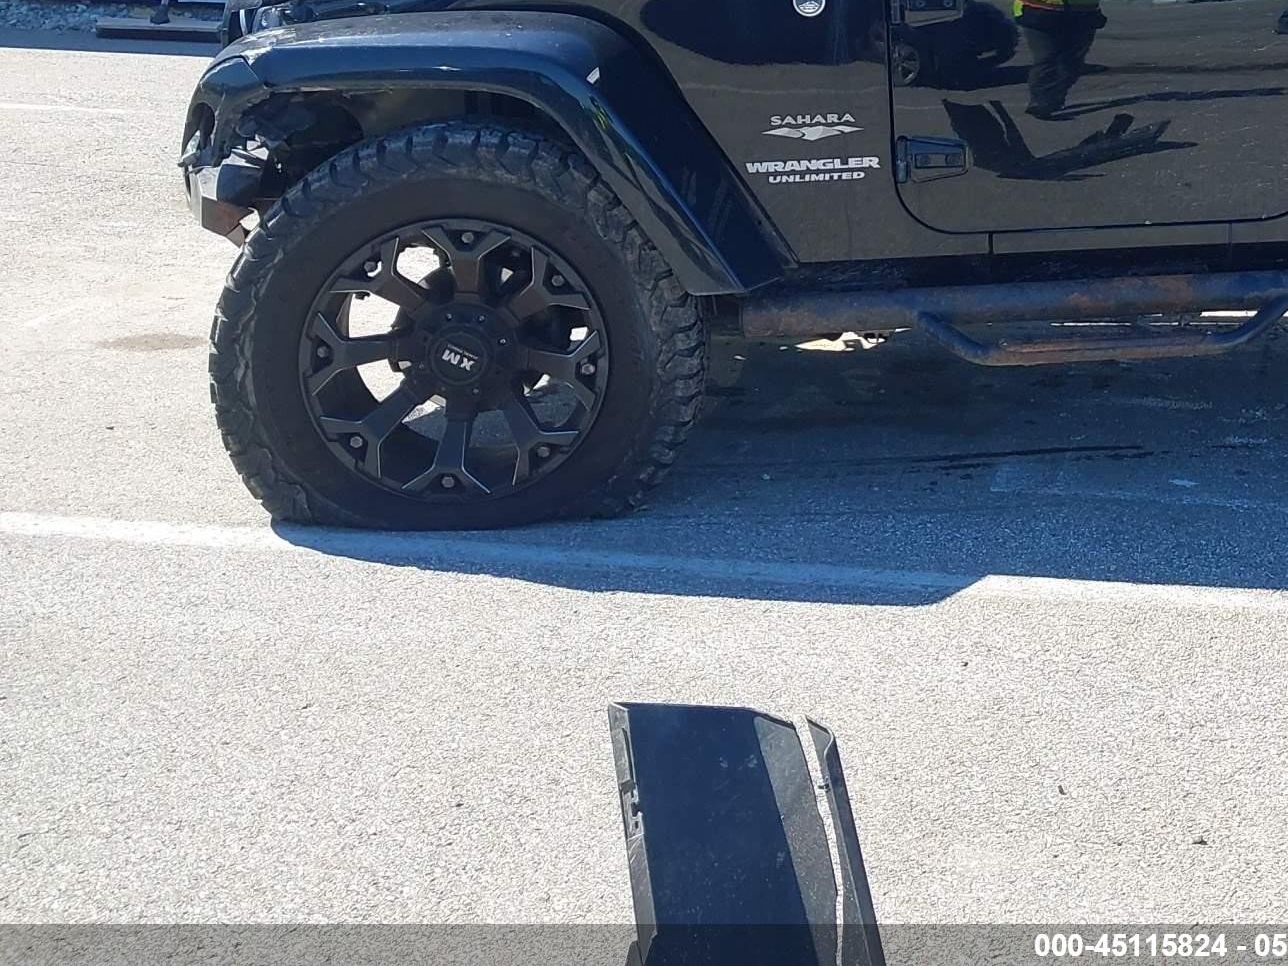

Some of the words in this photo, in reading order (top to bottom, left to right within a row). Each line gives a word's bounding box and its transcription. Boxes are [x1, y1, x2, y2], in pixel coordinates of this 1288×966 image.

[770, 113, 855, 126] SAHARA
[745, 156, 881, 173] WRANGLER
[768, 171, 865, 184] UNLIMITED
